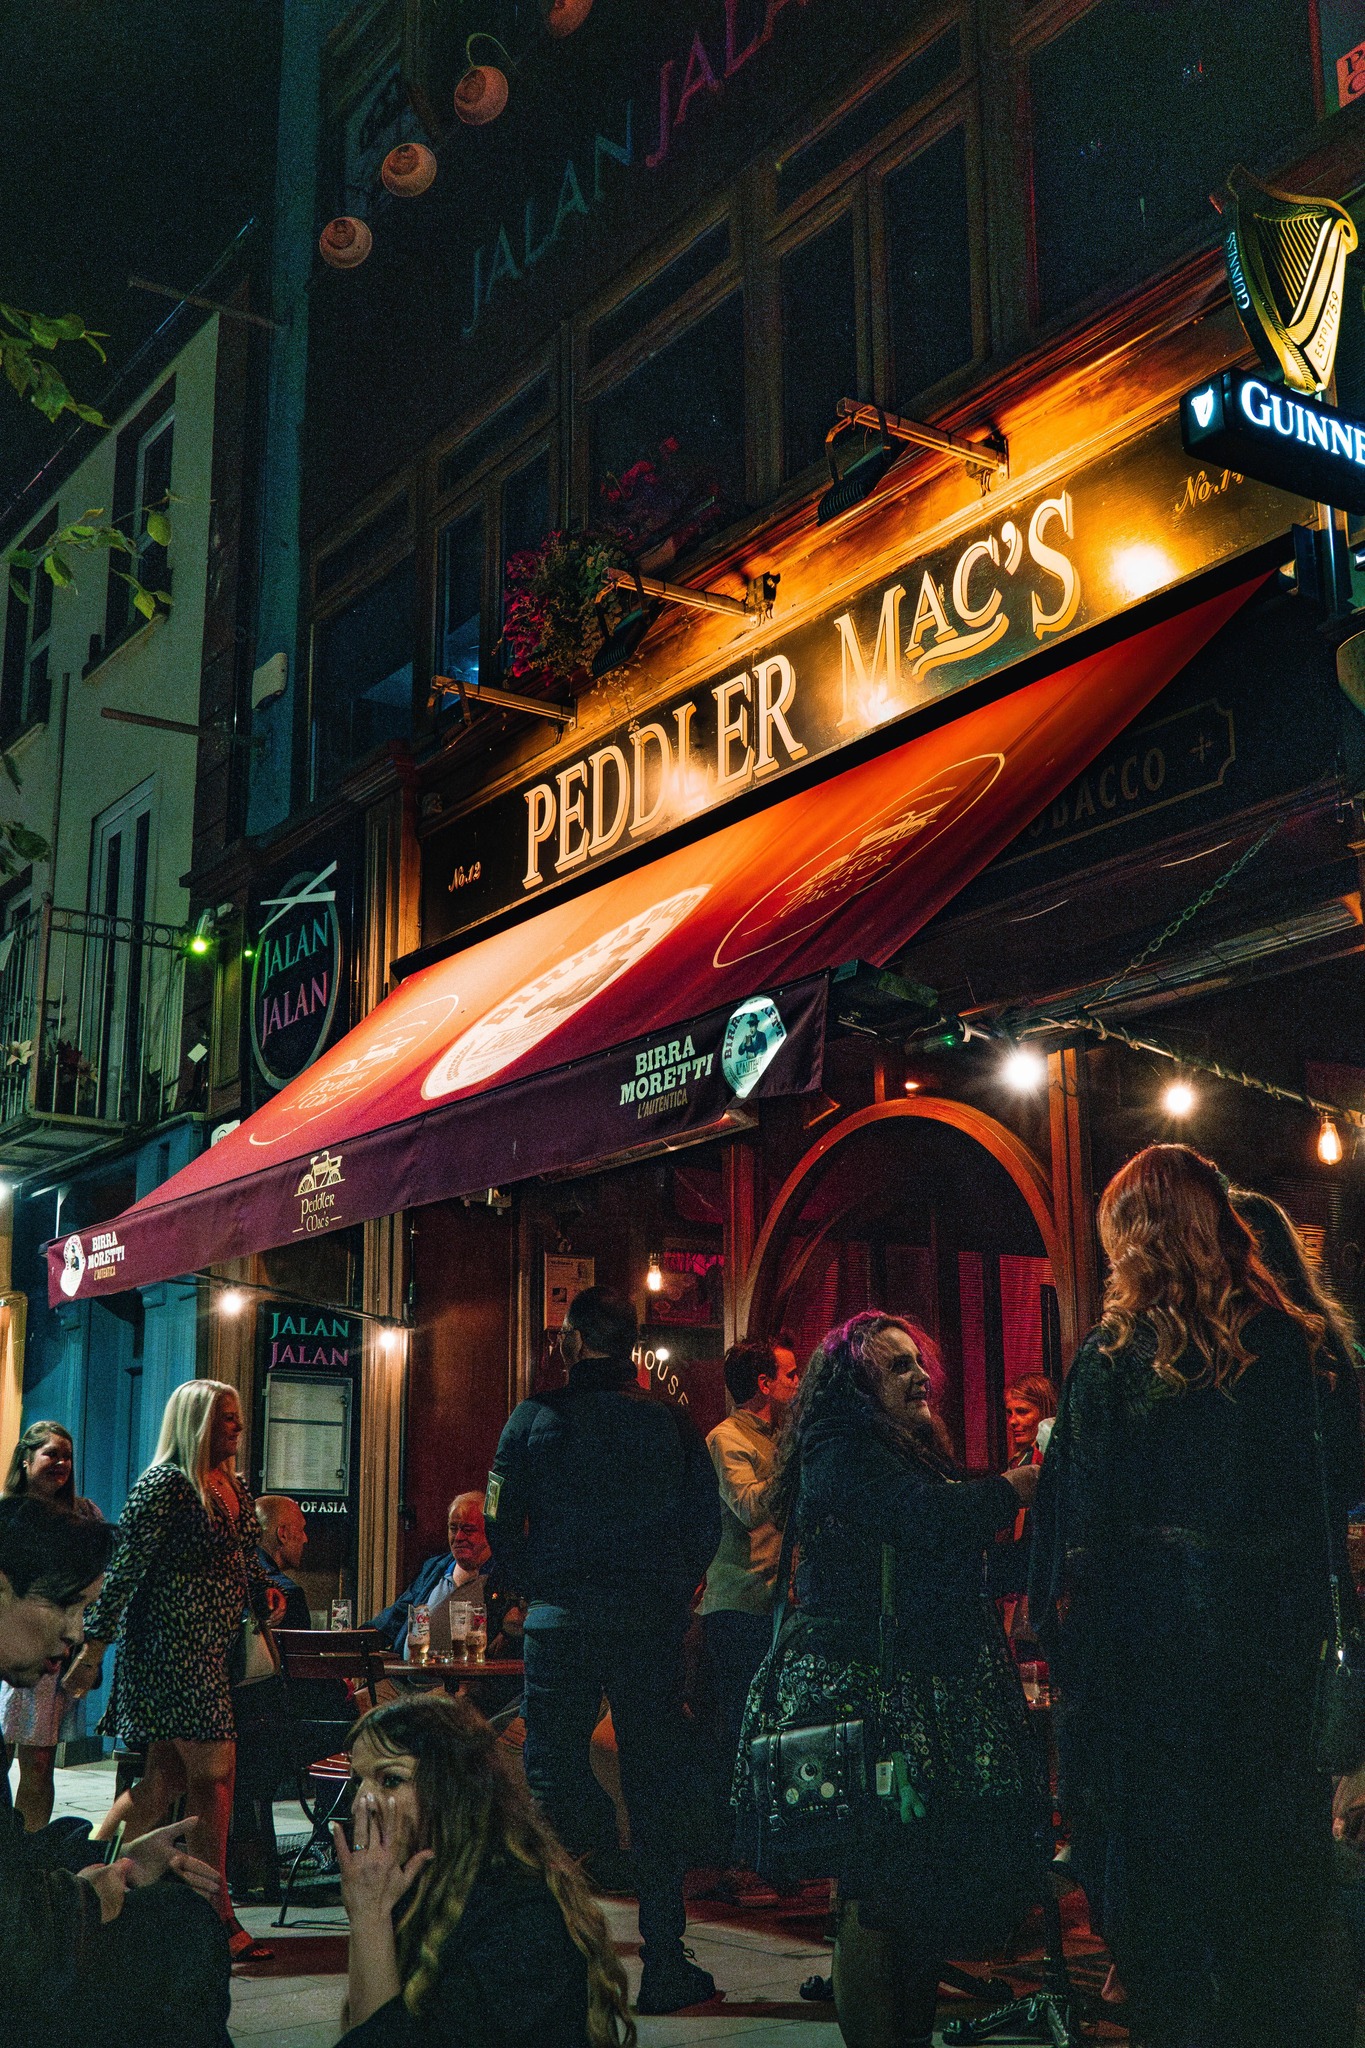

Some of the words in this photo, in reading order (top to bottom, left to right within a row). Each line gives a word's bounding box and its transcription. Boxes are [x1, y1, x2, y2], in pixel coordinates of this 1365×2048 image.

[462, 98, 634, 337] JALAN
[1226, 231, 1250, 310] GUINNESS
[522, 654, 808, 889] PEDDLER
[833, 490, 1081, 734] MAC'S
[261, 911, 329, 996] JALAN
[260, 970, 328, 1050] JALAN
[635, 1035, 696, 1077] BIRRA
[620, 1053, 714, 1106] MORETTI
[637, 1087, 689, 1120] L'AUTENTICA
[87, 1245, 125, 1270] MORETTI
[92, 1231, 118, 1252] BIRRA
[270, 1312, 349, 1340] JALAN
[269, 1341, 349, 1369] JALAN
[300, 1501, 317, 1513] OF
[318, 1501, 348, 1513] ASIA
